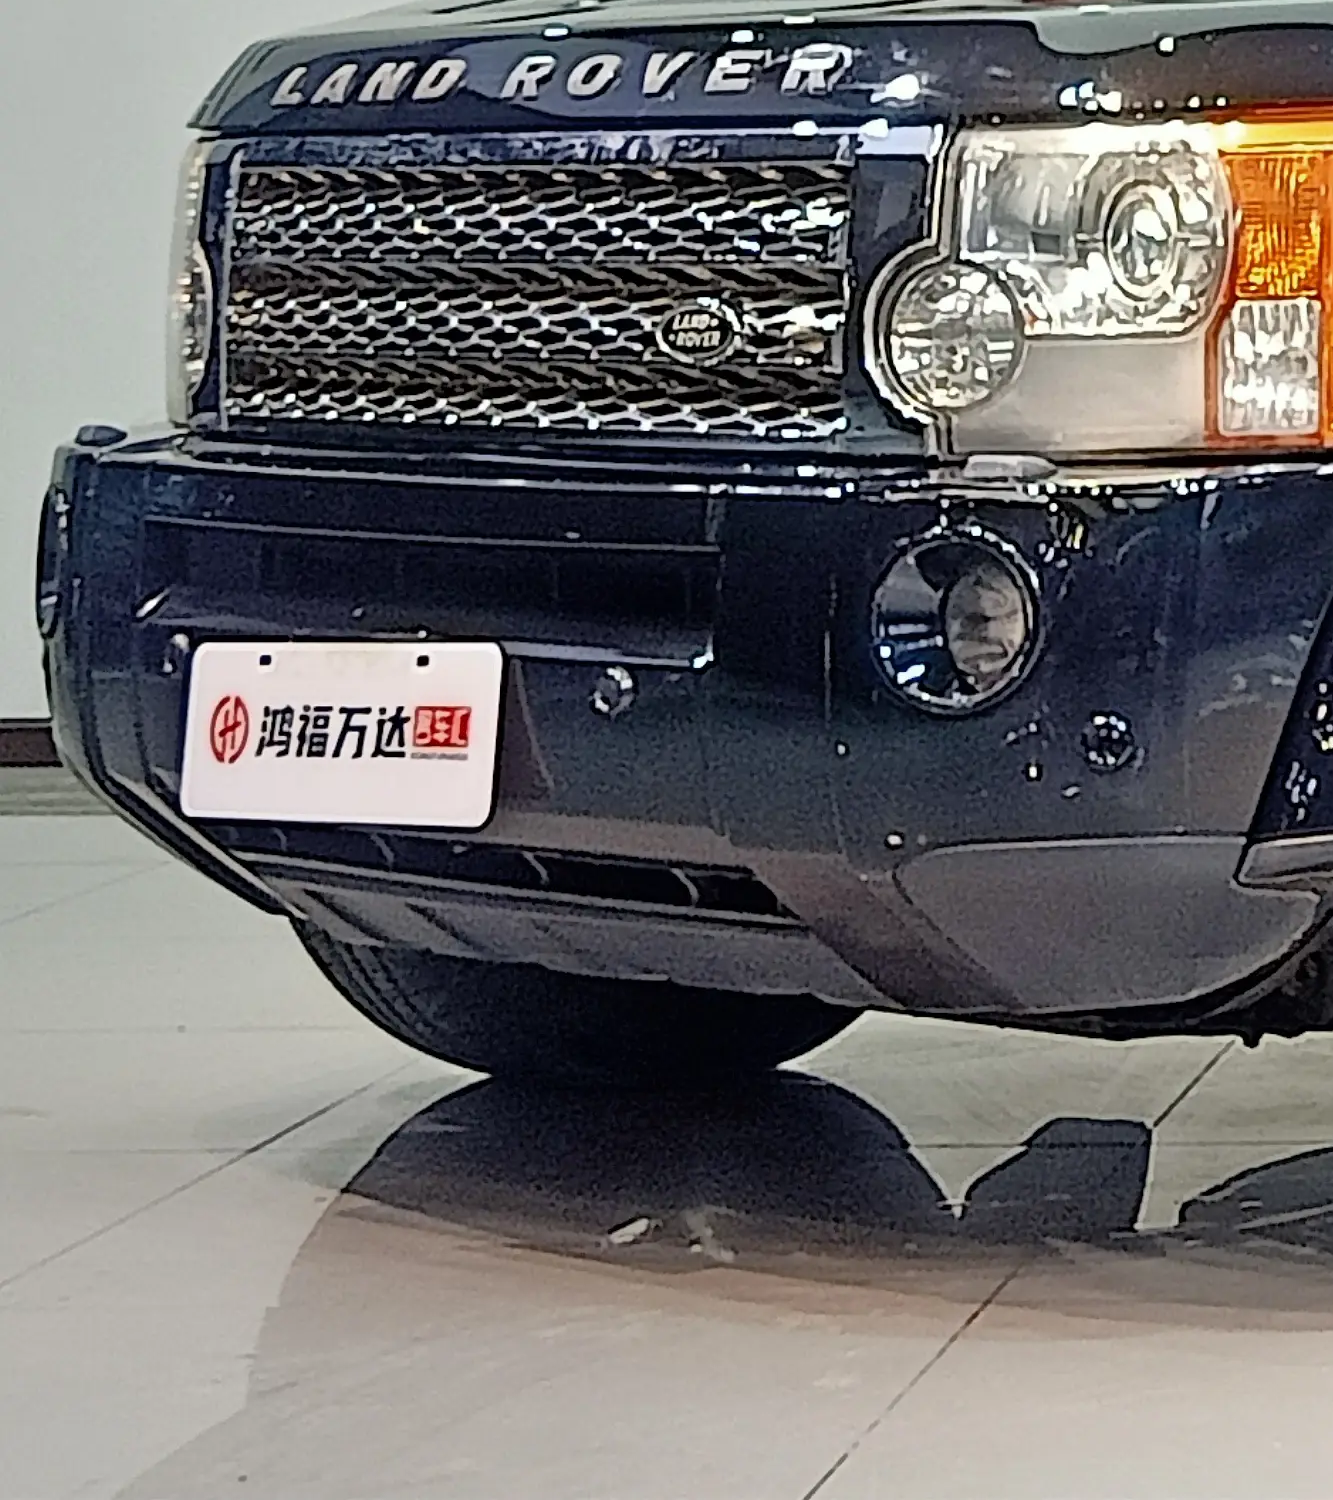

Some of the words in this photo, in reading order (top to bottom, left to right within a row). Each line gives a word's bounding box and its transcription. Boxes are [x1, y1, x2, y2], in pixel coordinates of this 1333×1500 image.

[270, 58, 467, 106] LAND
[501, 45, 854, 100] ROVER
[254, 705, 410, 759] 鸿福万达
